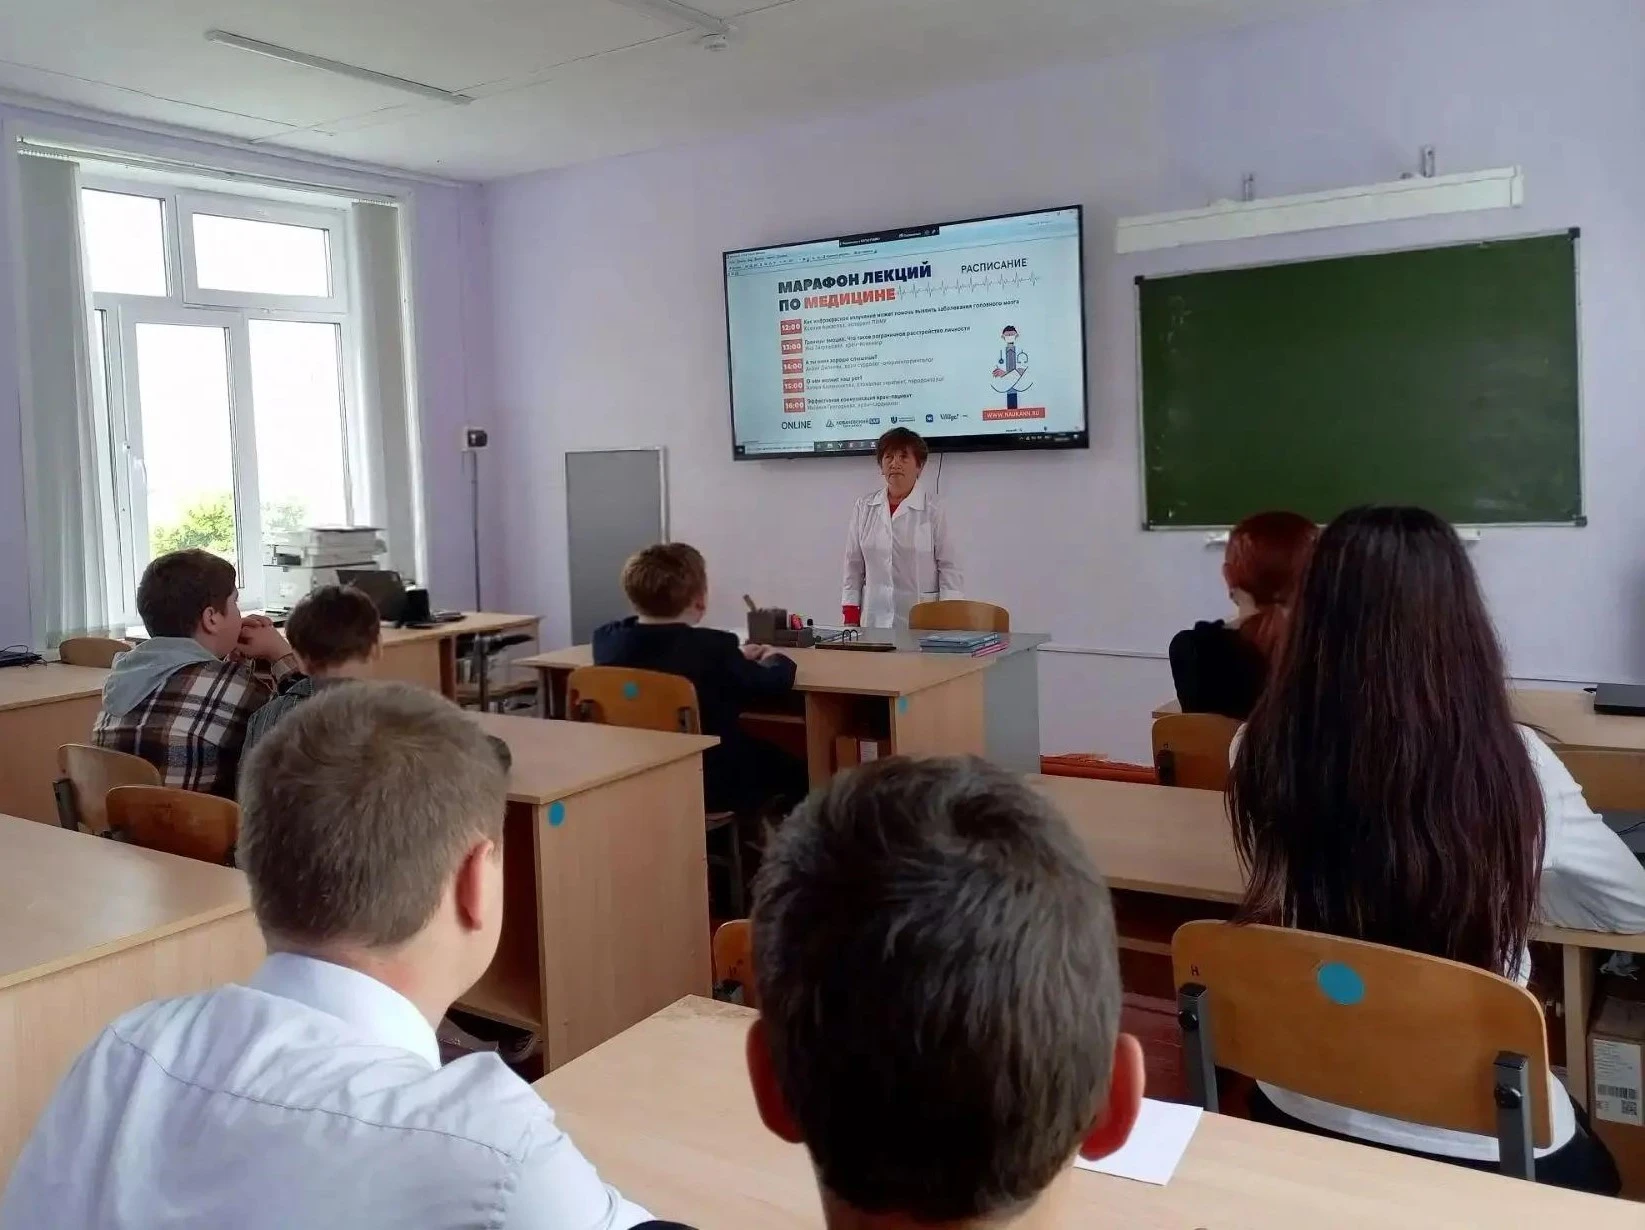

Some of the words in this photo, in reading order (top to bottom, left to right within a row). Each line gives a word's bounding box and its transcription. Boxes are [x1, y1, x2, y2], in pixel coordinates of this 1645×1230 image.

[961, 258, 1027, 274] РАСПИСАНИЕ
[778, 274, 859, 294] МАРАФОН
[862, 260, 932, 284] ЛЕКЦИЙ
[779, 298, 801, 312] ПО
[804, 287, 896, 309] МЕДИЦИНЕ
[973, 301, 1002, 309] головного
[781, 323, 801, 331] 12:00
[944, 325, 971, 333] личности
[782, 343, 801, 351] 13:00
[783, 361, 802, 369] 14:00
[784, 382, 803, 390] 15:00
[785, 401, 804, 409] 16:00
[986, 410, 1040, 419] WWW.NAUKANN.RU
[781, 420, 812, 430] ONLINE
